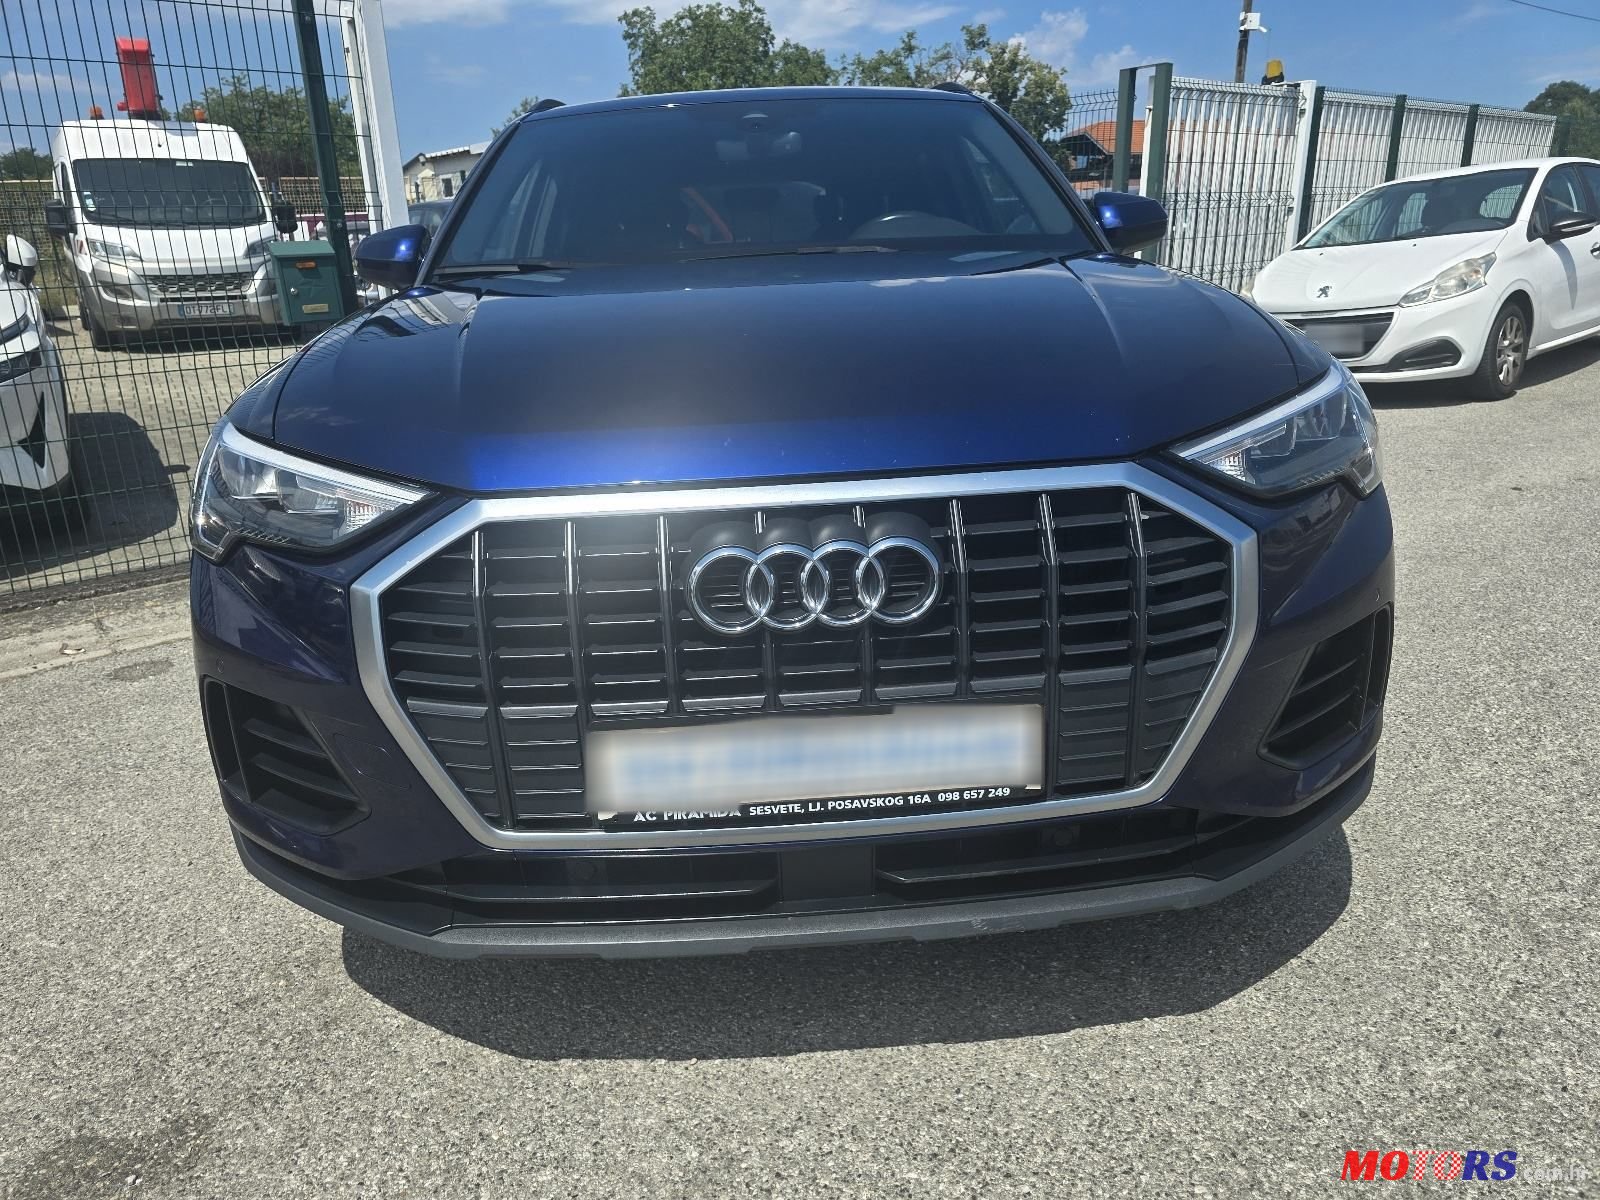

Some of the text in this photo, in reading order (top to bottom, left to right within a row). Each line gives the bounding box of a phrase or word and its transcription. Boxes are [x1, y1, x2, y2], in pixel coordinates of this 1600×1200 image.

[633, 810, 657, 822] AC
[749, 803, 805, 816] SESVETE,
[808, 802, 824, 812] LJ.
[827, 796, 904, 810] POSAVSKOG
[907, 794, 932, 805] 16A
[937, 791, 960, 802] 098
[963, 789, 985, 800] 657
[987, 787, 1011, 798] 249
